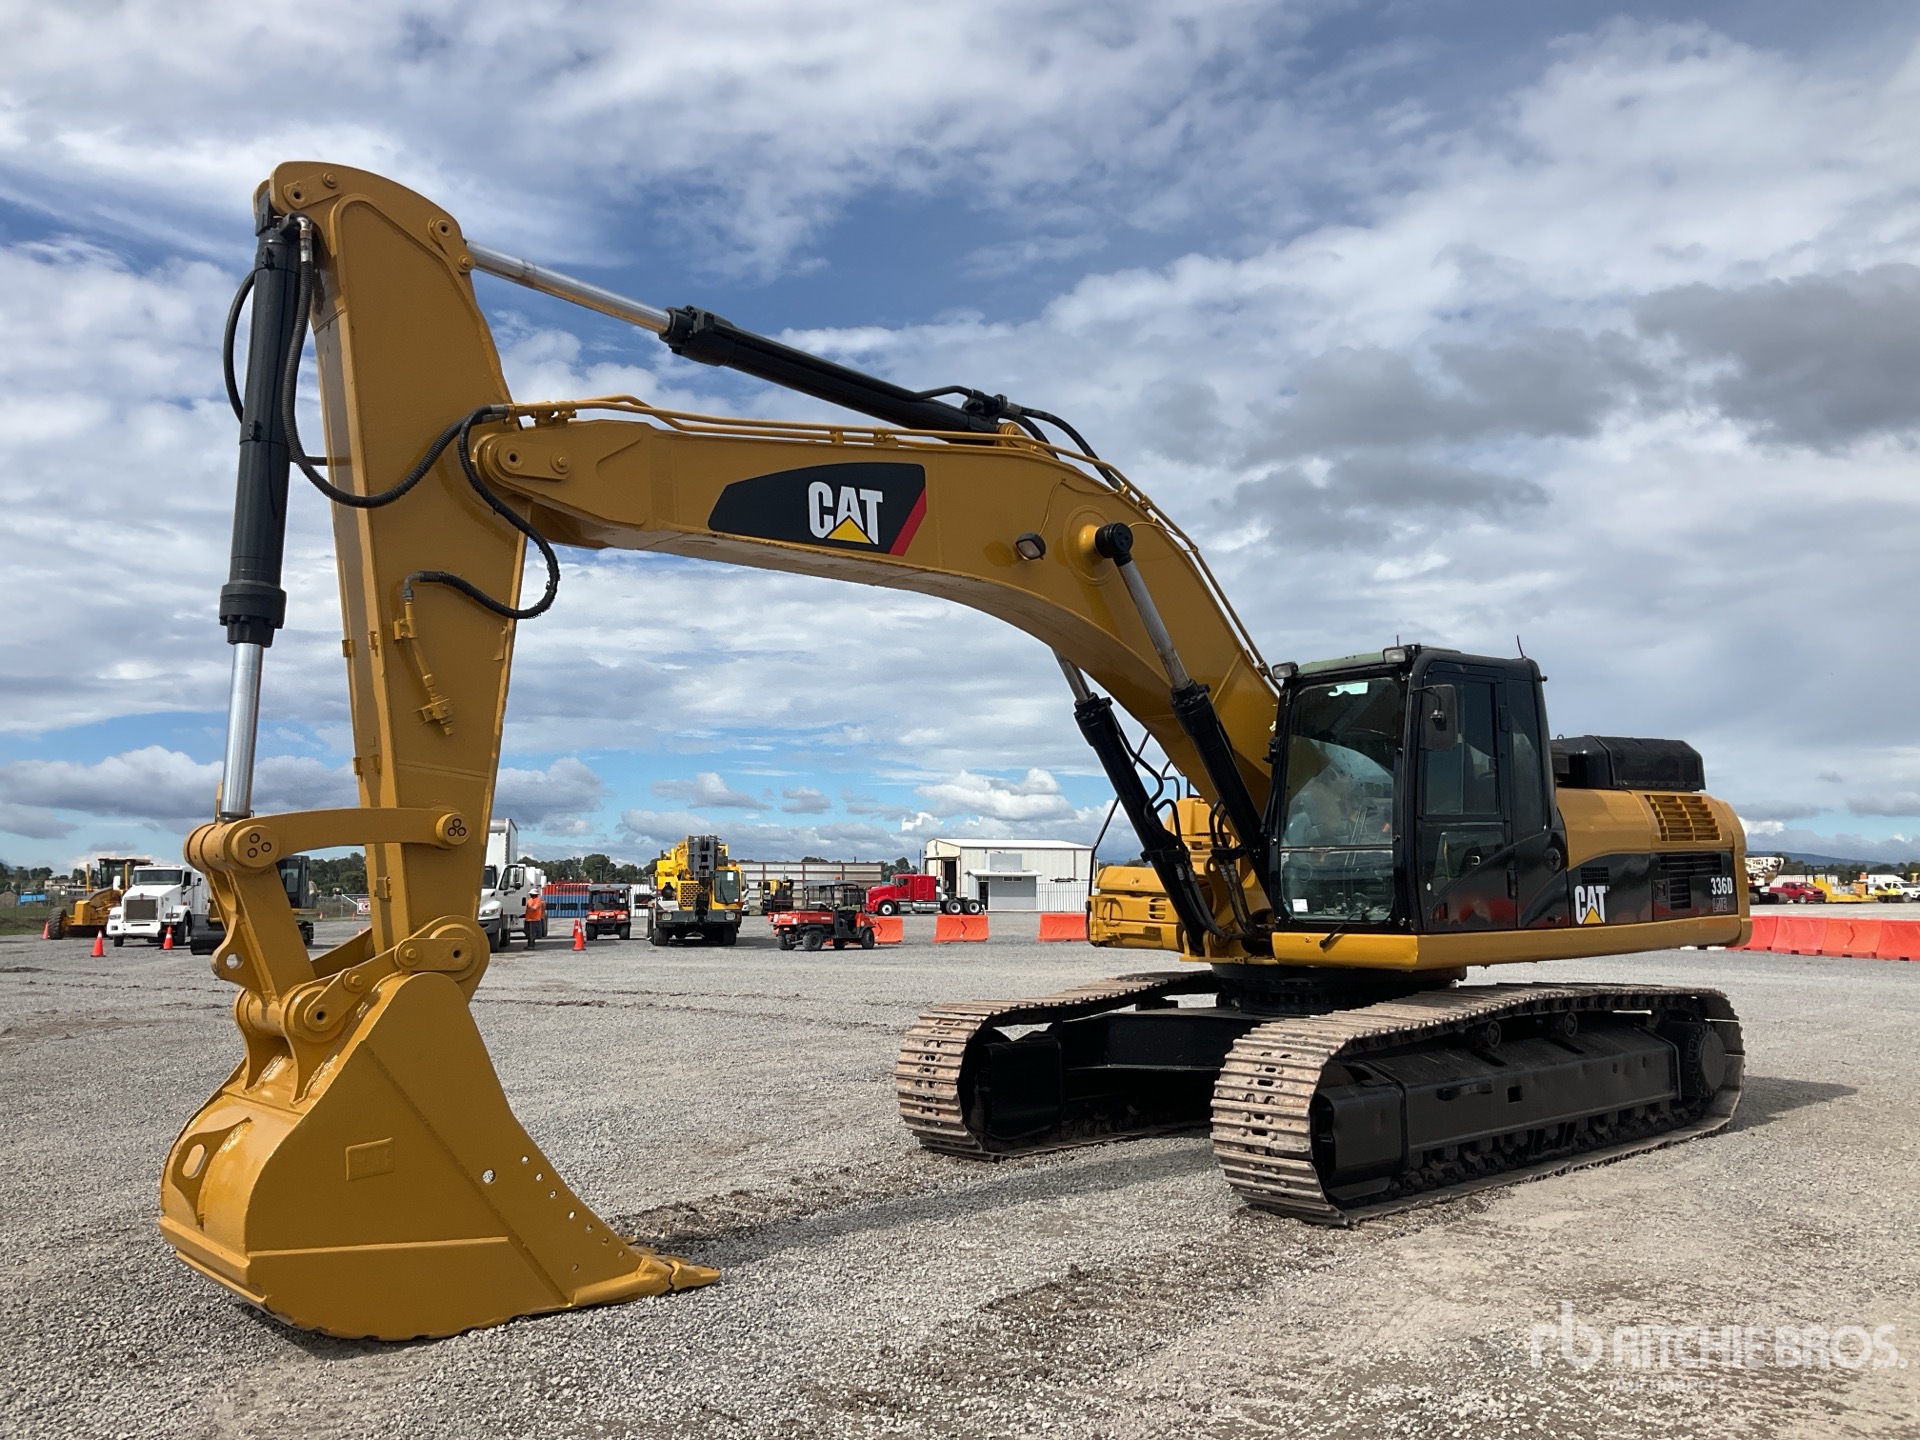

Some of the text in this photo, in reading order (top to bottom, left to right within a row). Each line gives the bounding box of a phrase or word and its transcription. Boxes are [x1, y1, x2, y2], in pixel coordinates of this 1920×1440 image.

[808, 481, 883, 545] CAT
[1574, 885, 1606, 924] CAT
[1710, 877, 1733, 895] 336D
